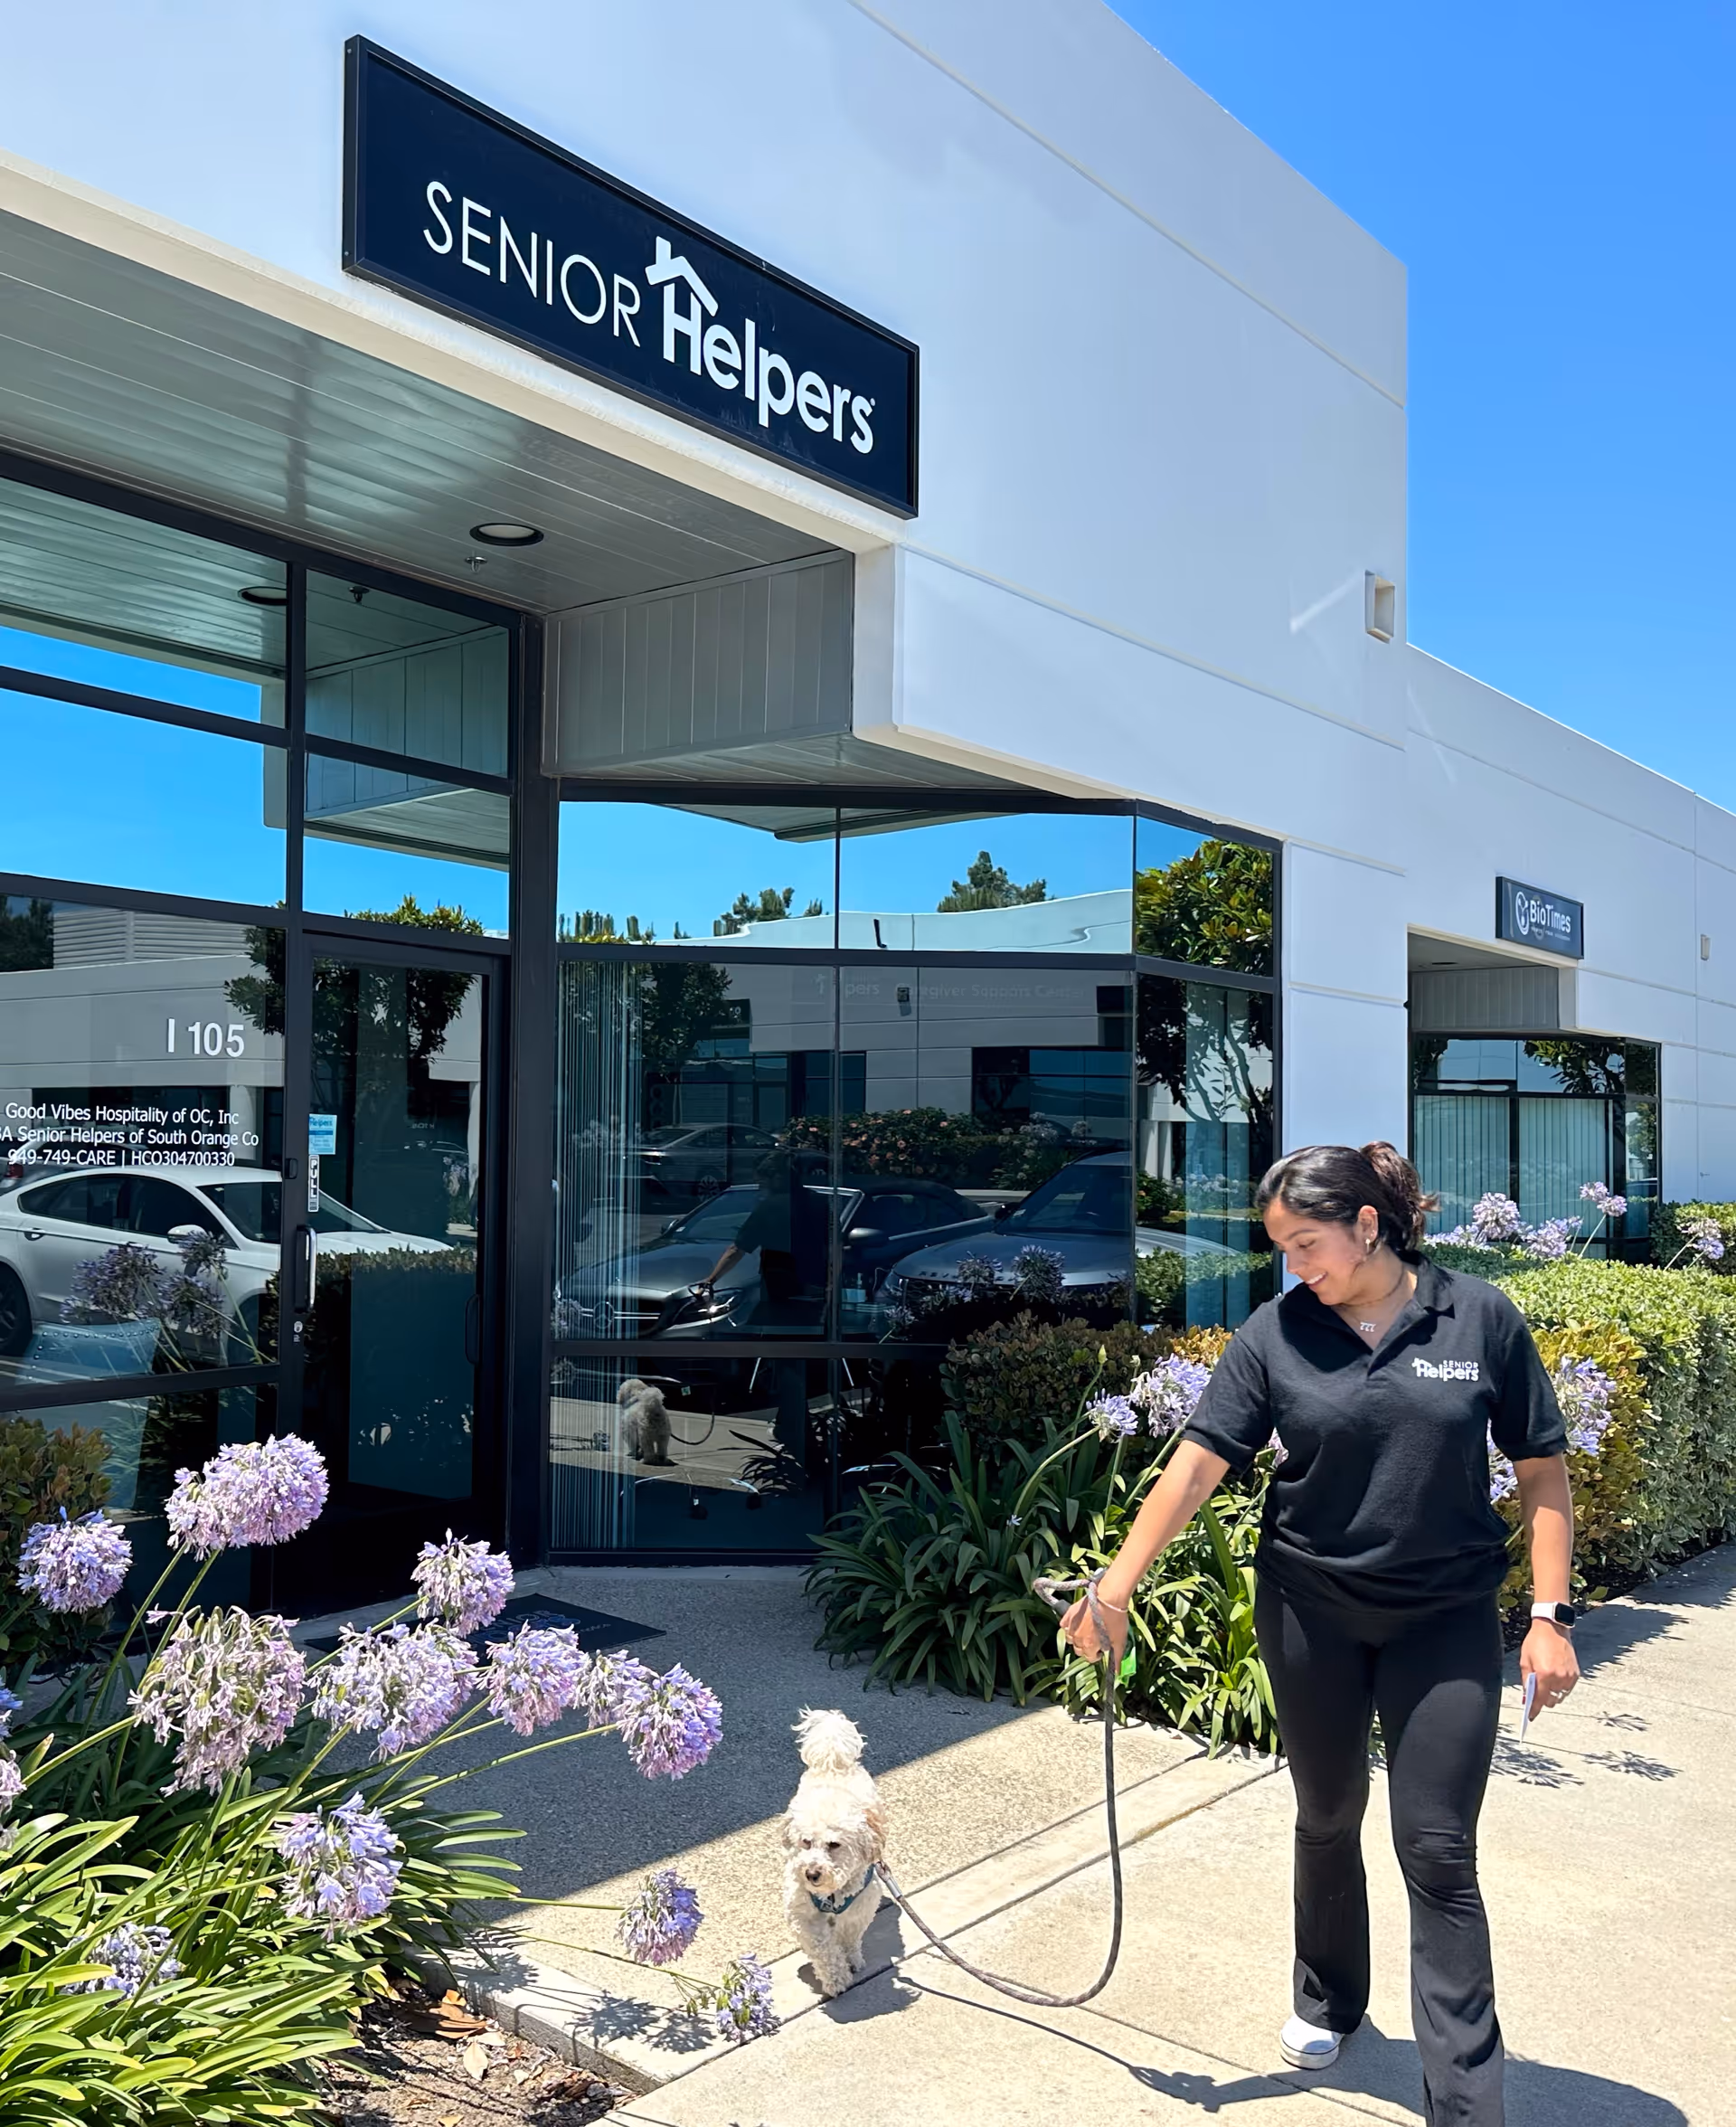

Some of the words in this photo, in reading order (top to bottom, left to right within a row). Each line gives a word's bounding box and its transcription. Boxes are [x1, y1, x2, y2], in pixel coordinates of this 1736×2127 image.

[423, 181, 641, 347] SENIOR
[661, 277, 874, 454] Helpers
[1530, 900, 1571, 933] BioTimes
[188, 1021, 244, 1057] 105
[5, 1102, 46, 1120] Good
[51, 1103, 91, 1120] Vibes
[95, 1106, 168, 1126] Hospitality
[172, 1108, 187, 1123] of
[190, 1109, 214, 1126] OC,
[218, 1110, 240, 1125] Inc
[17, 1126, 66, 1143] Senior
[71, 1128, 125, 1146] Helpers
[129, 1129, 144, 1144] of
[147, 1129, 187, 1145] South
[192, 1130, 239, 1149] Orange
[241, 1131, 259, 1146] Co
[8, 1149, 117, 1166] 949-749-CARE
[131, 1150, 235, 1167] HCO304700330
[1415, 1360, 1480, 1382] Helpers
[1442, 1359, 1479, 1370] SENIOR
